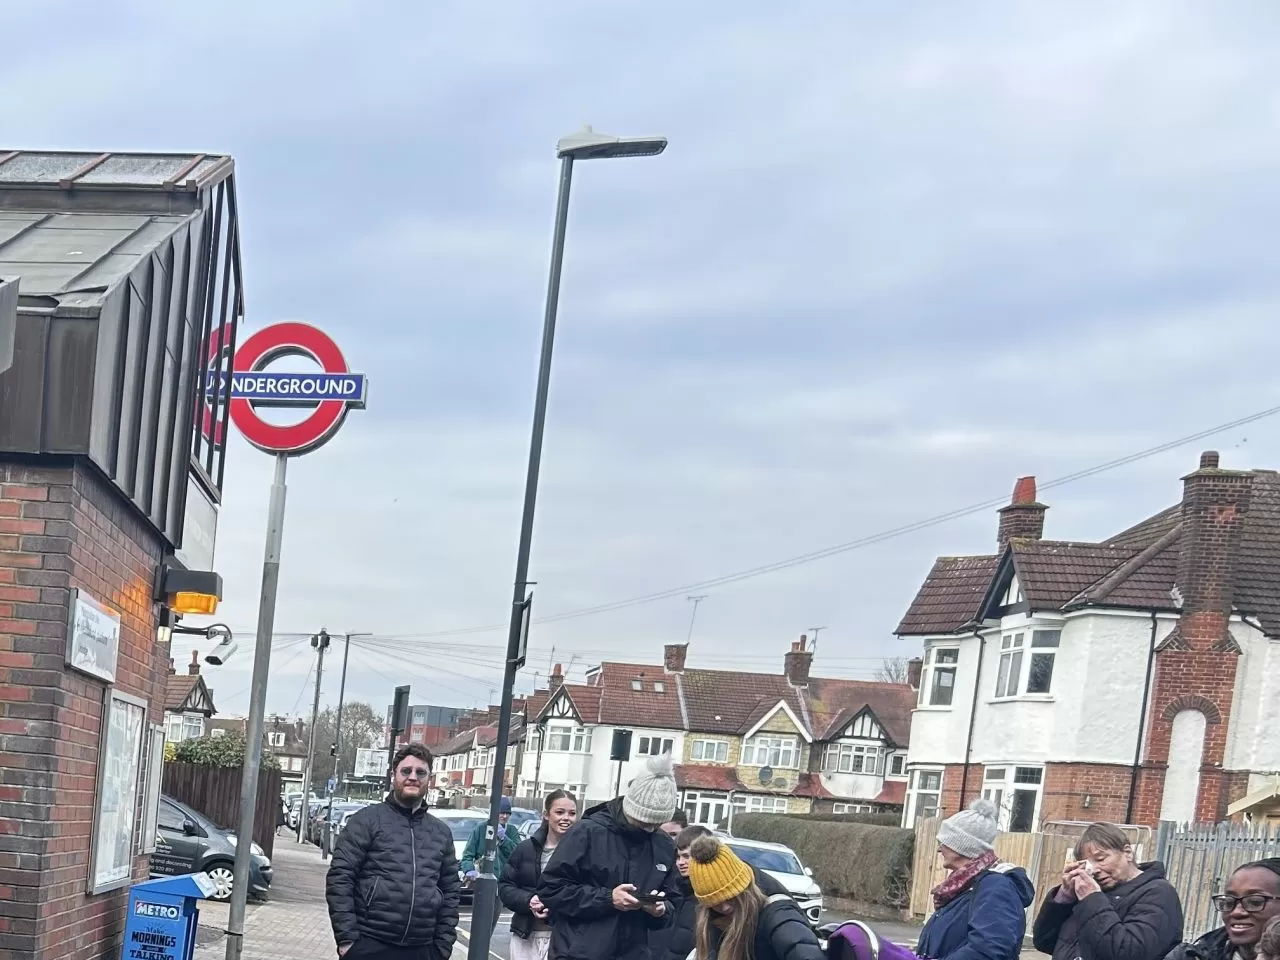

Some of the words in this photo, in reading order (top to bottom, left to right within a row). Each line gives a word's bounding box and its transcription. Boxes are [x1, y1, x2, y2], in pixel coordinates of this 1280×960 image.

[230, 377, 357, 395] NDERGROUND
[136, 903, 178, 918] METRO
[131, 931, 177, 947] MORNINGS
